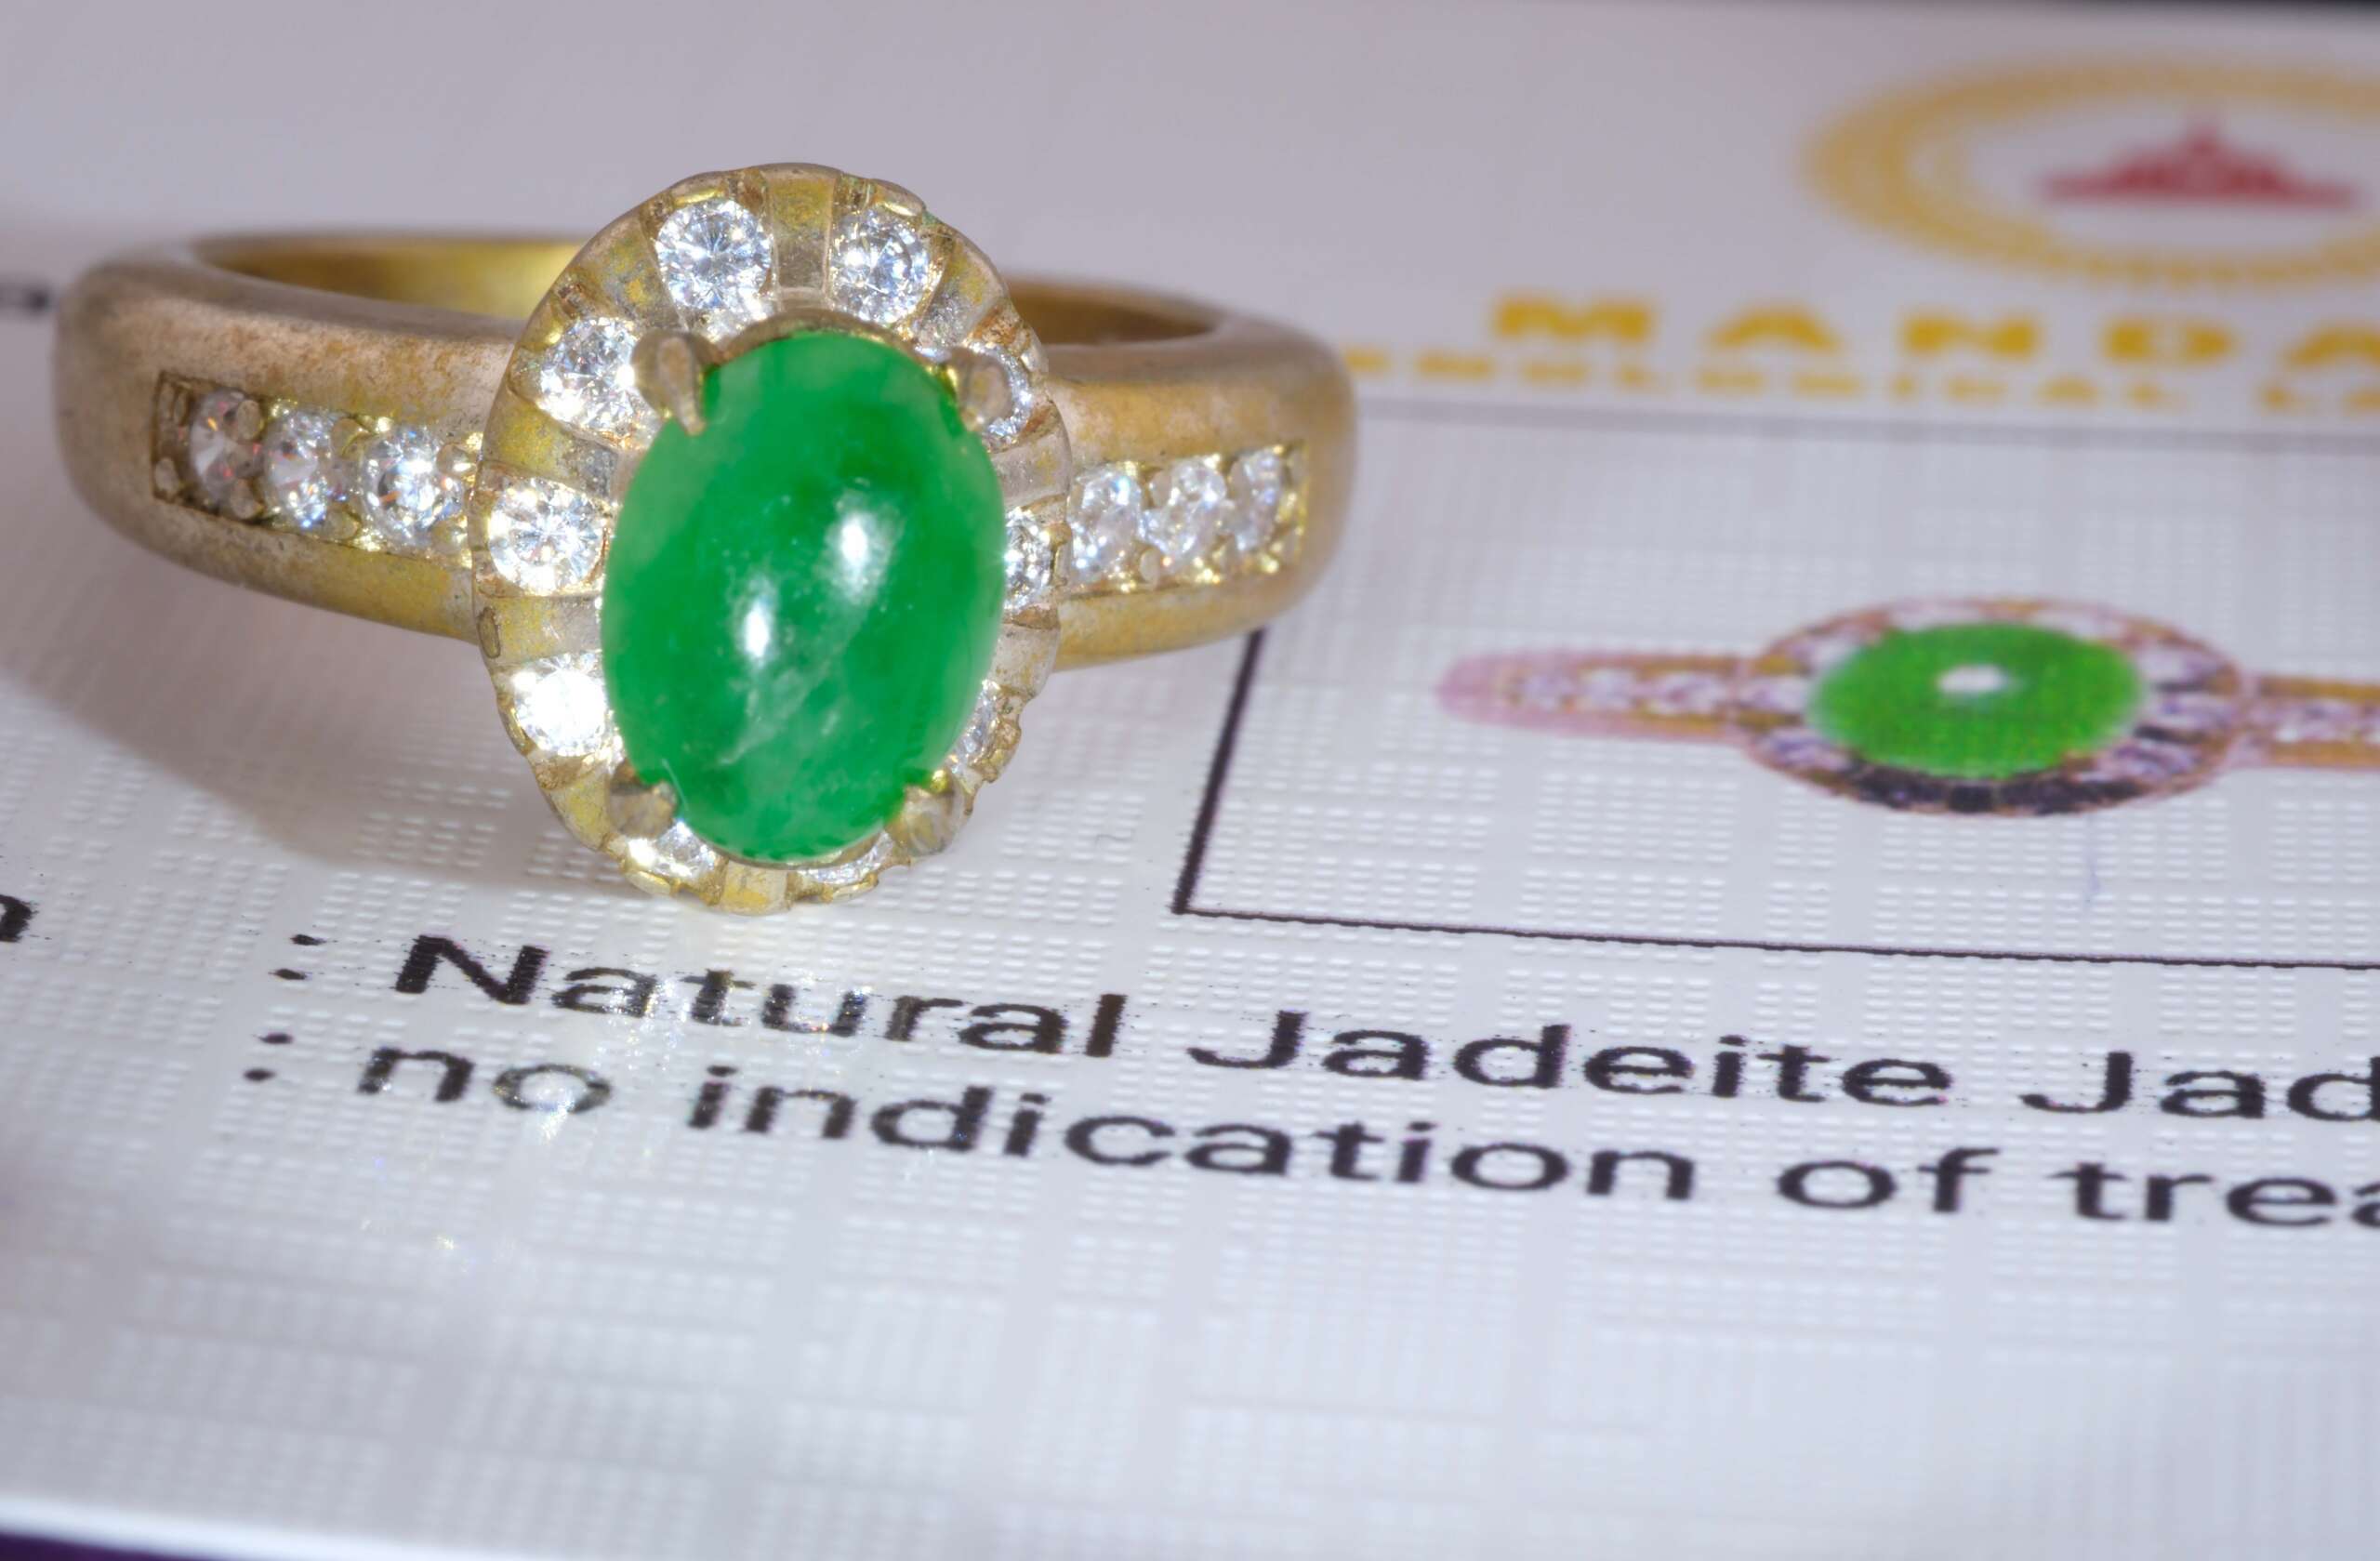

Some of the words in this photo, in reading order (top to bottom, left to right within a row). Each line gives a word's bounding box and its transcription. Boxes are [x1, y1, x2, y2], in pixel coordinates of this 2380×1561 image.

[394, 934, 1127, 1057] Natural
[1186, 1010, 1954, 1108] Jadeite
[2020, 1052, 2380, 1121] Jad
[357, 1047, 613, 1114] no
[688, 1065, 1698, 1200] indication
[1777, 1147, 2001, 1213] of
